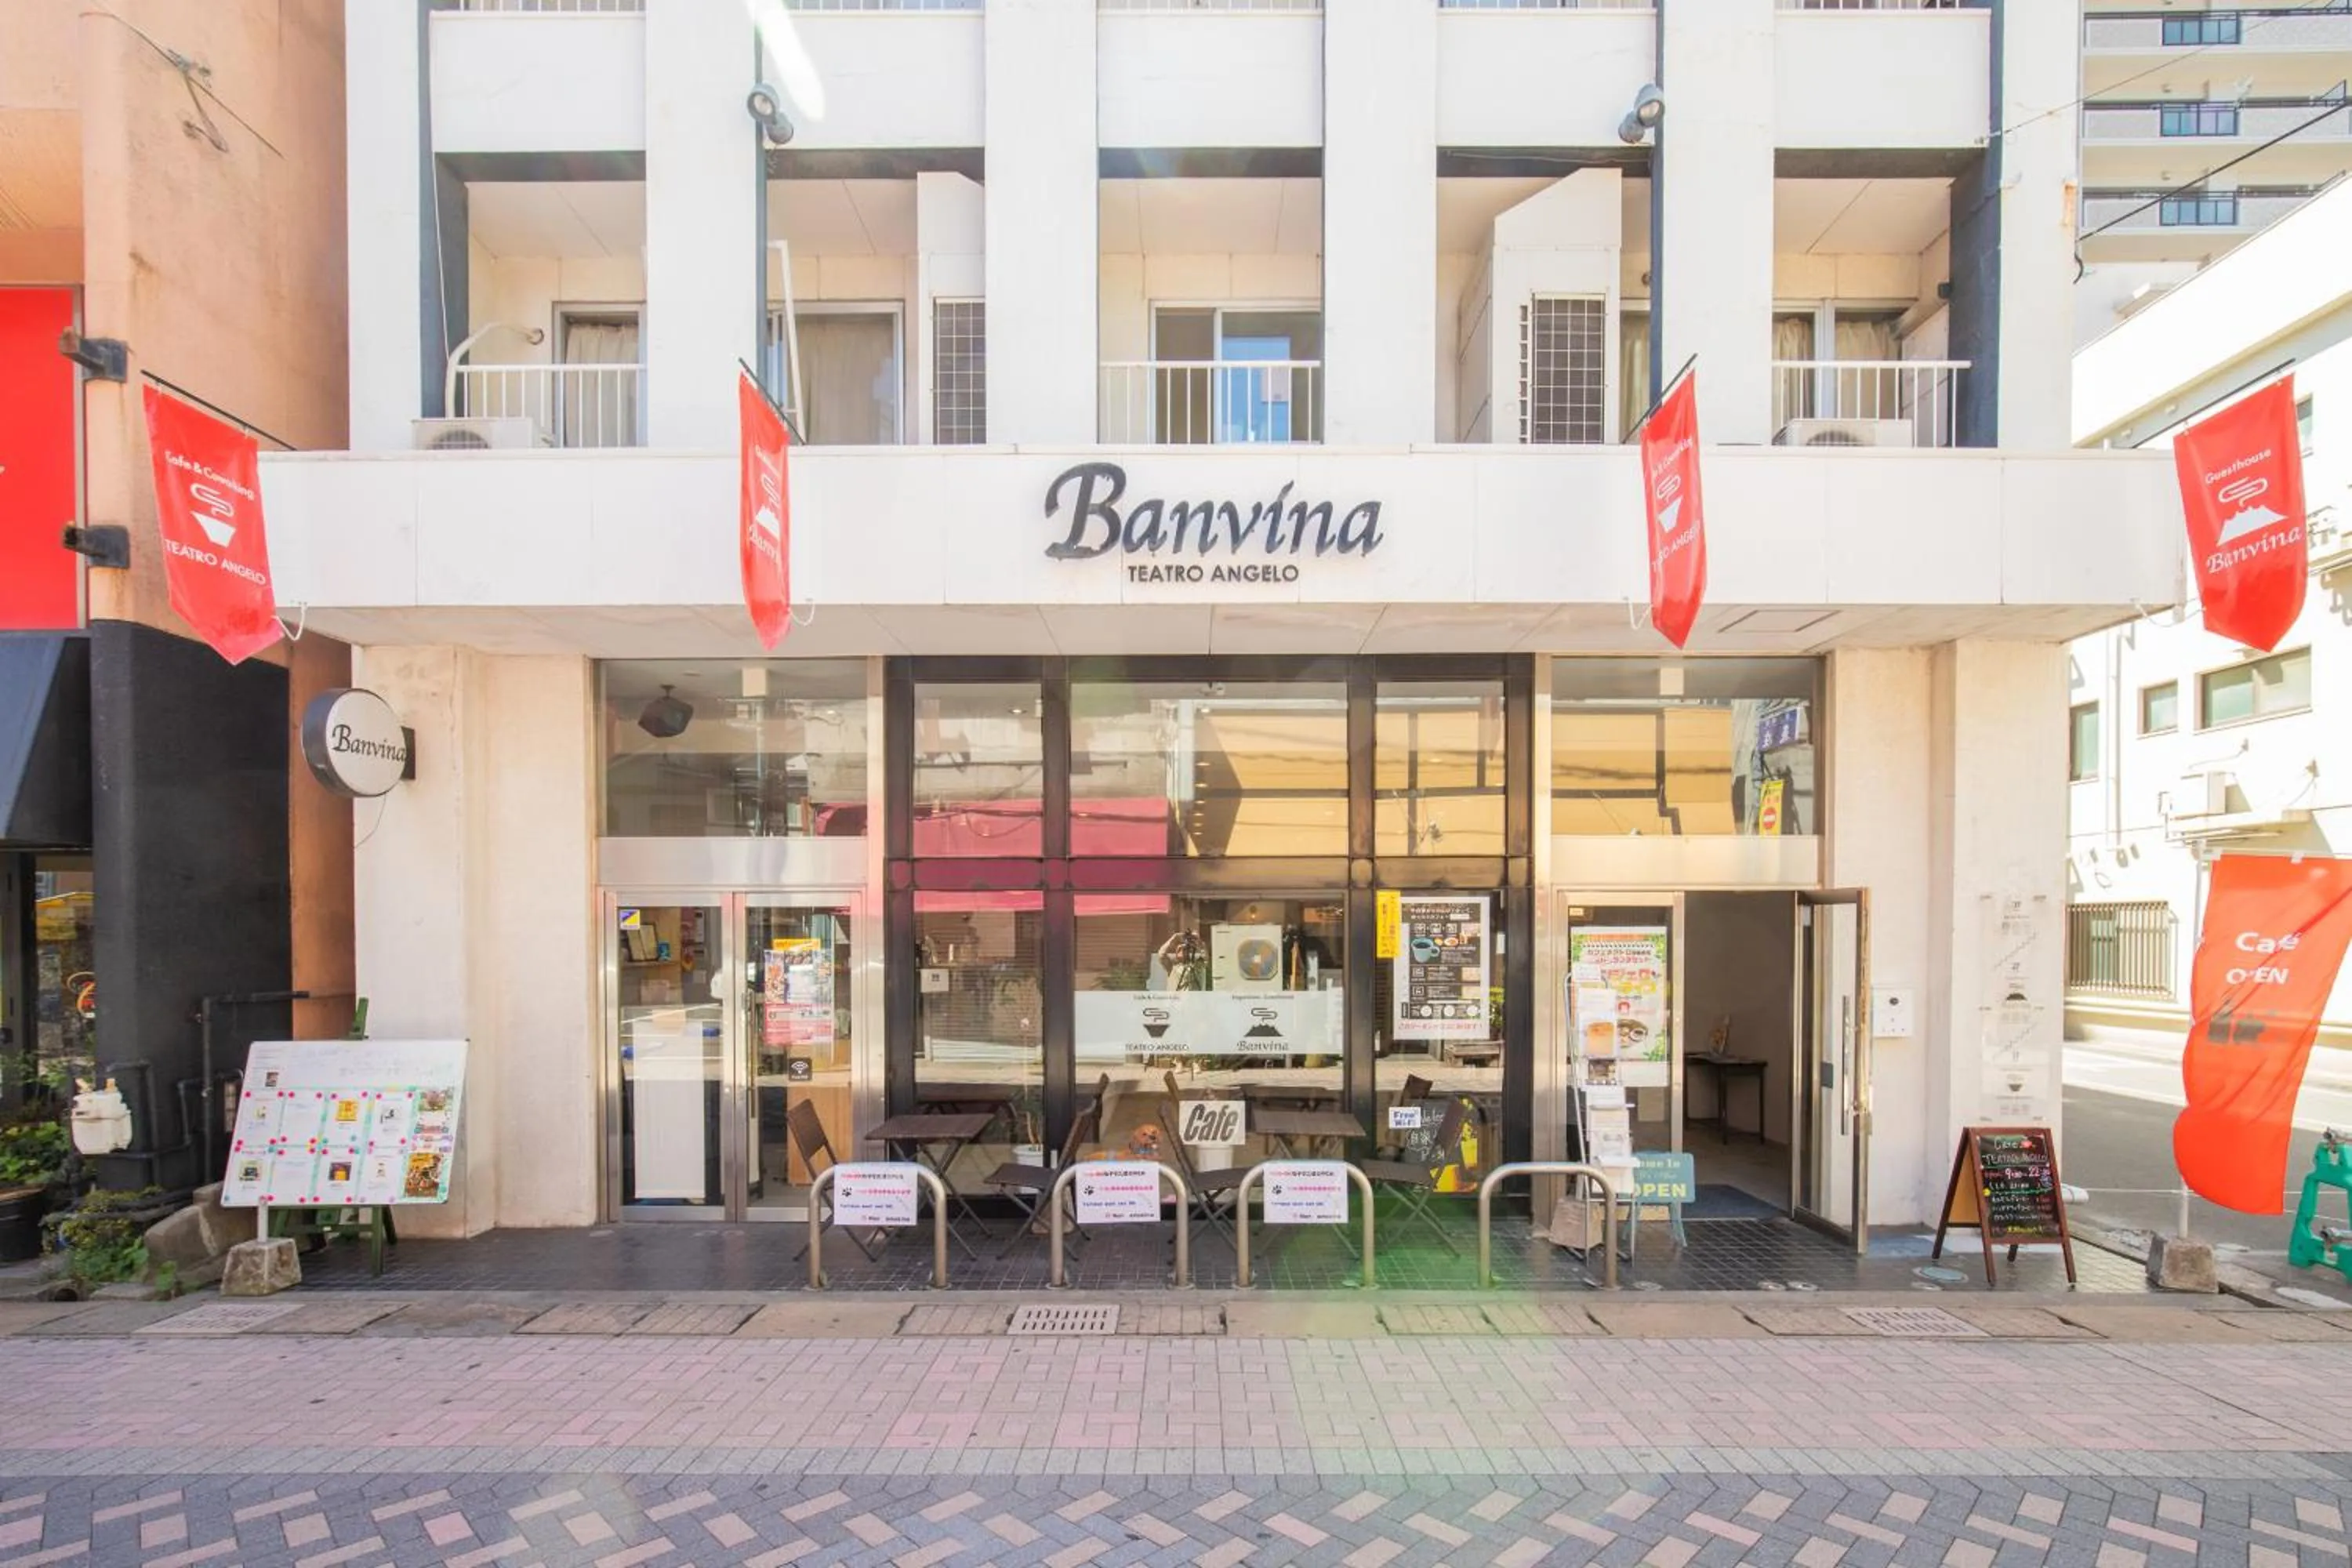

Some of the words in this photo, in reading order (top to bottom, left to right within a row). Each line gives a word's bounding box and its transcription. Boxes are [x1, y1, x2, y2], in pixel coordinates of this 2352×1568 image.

[2205, 448, 2271, 484] Guesthouse
[165, 539, 218, 566] TEATRO
[220, 557, 266, 586] ANGELO
[1127, 564, 1203, 583] TEATRO
[1210, 564, 1299, 583] ANGELO
[332, 724, 407, 762] Banvina
[1183, 1103, 1239, 1142] Cafe
